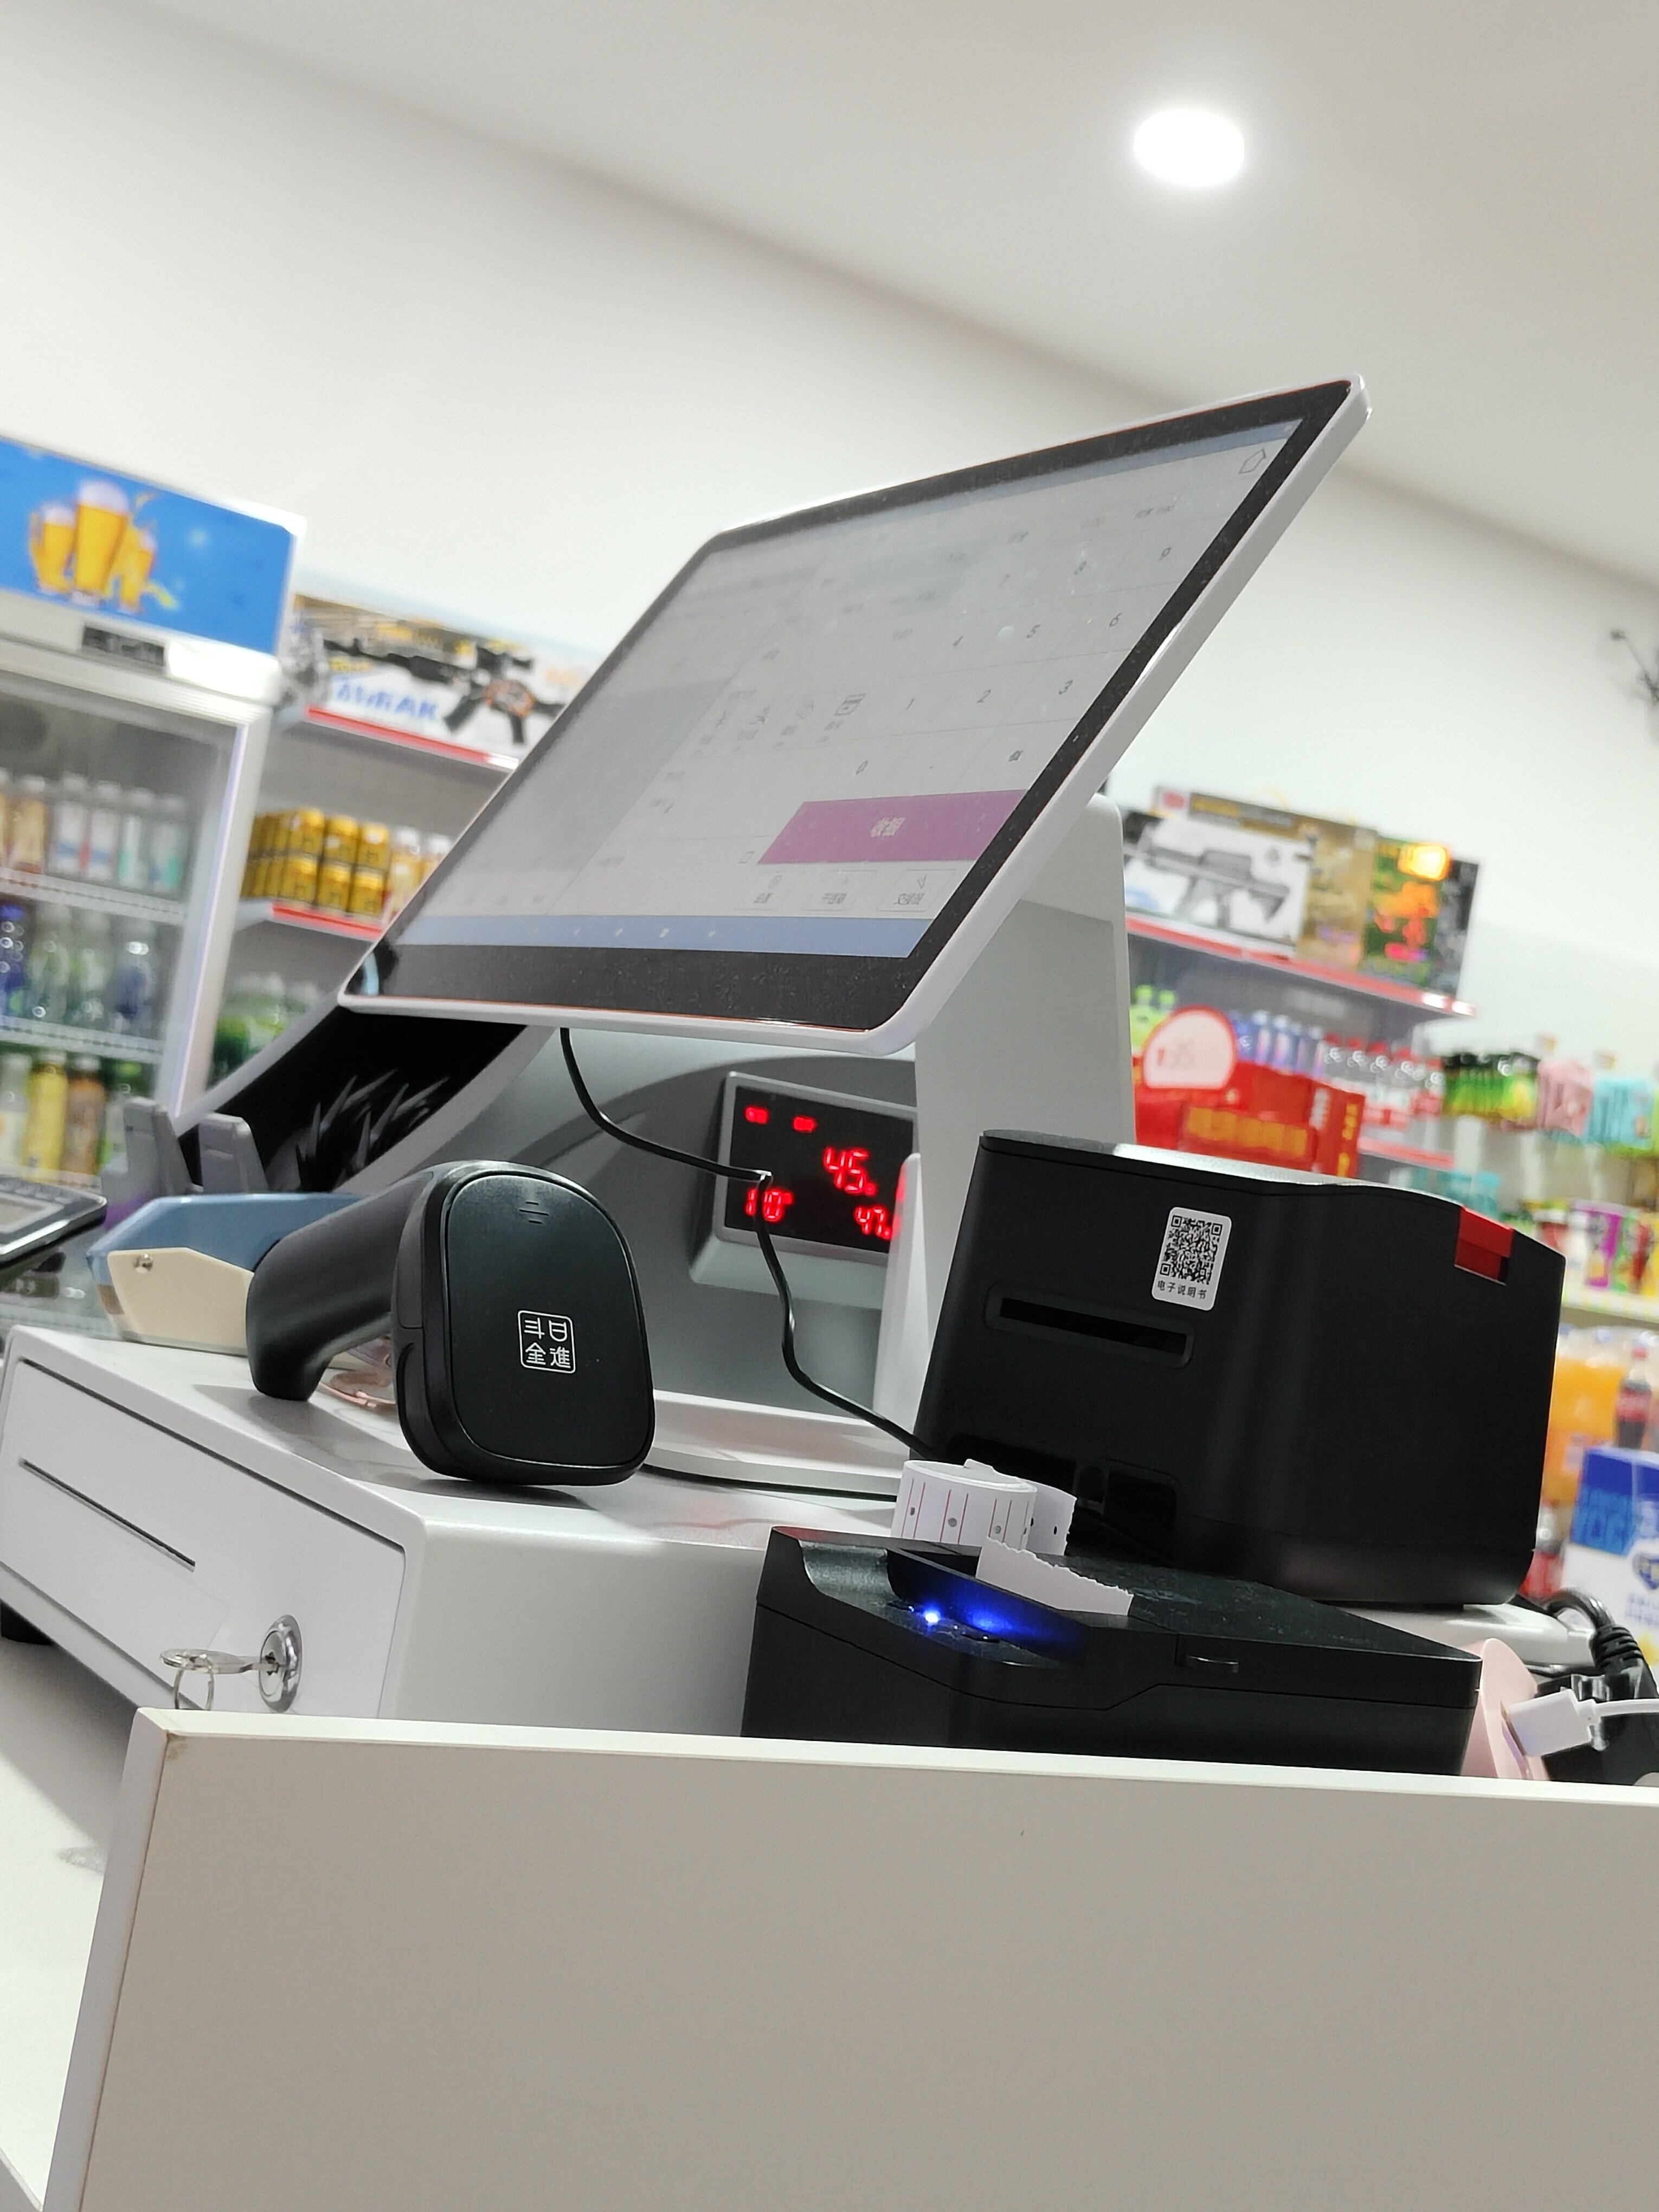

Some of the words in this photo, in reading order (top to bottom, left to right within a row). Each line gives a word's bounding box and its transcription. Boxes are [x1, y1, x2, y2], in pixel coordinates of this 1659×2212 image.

[978, 690, 991, 703] 2
[1058, 680, 1073, 695] 3
[1158, 1280, 1207, 1299] 电子说明书
